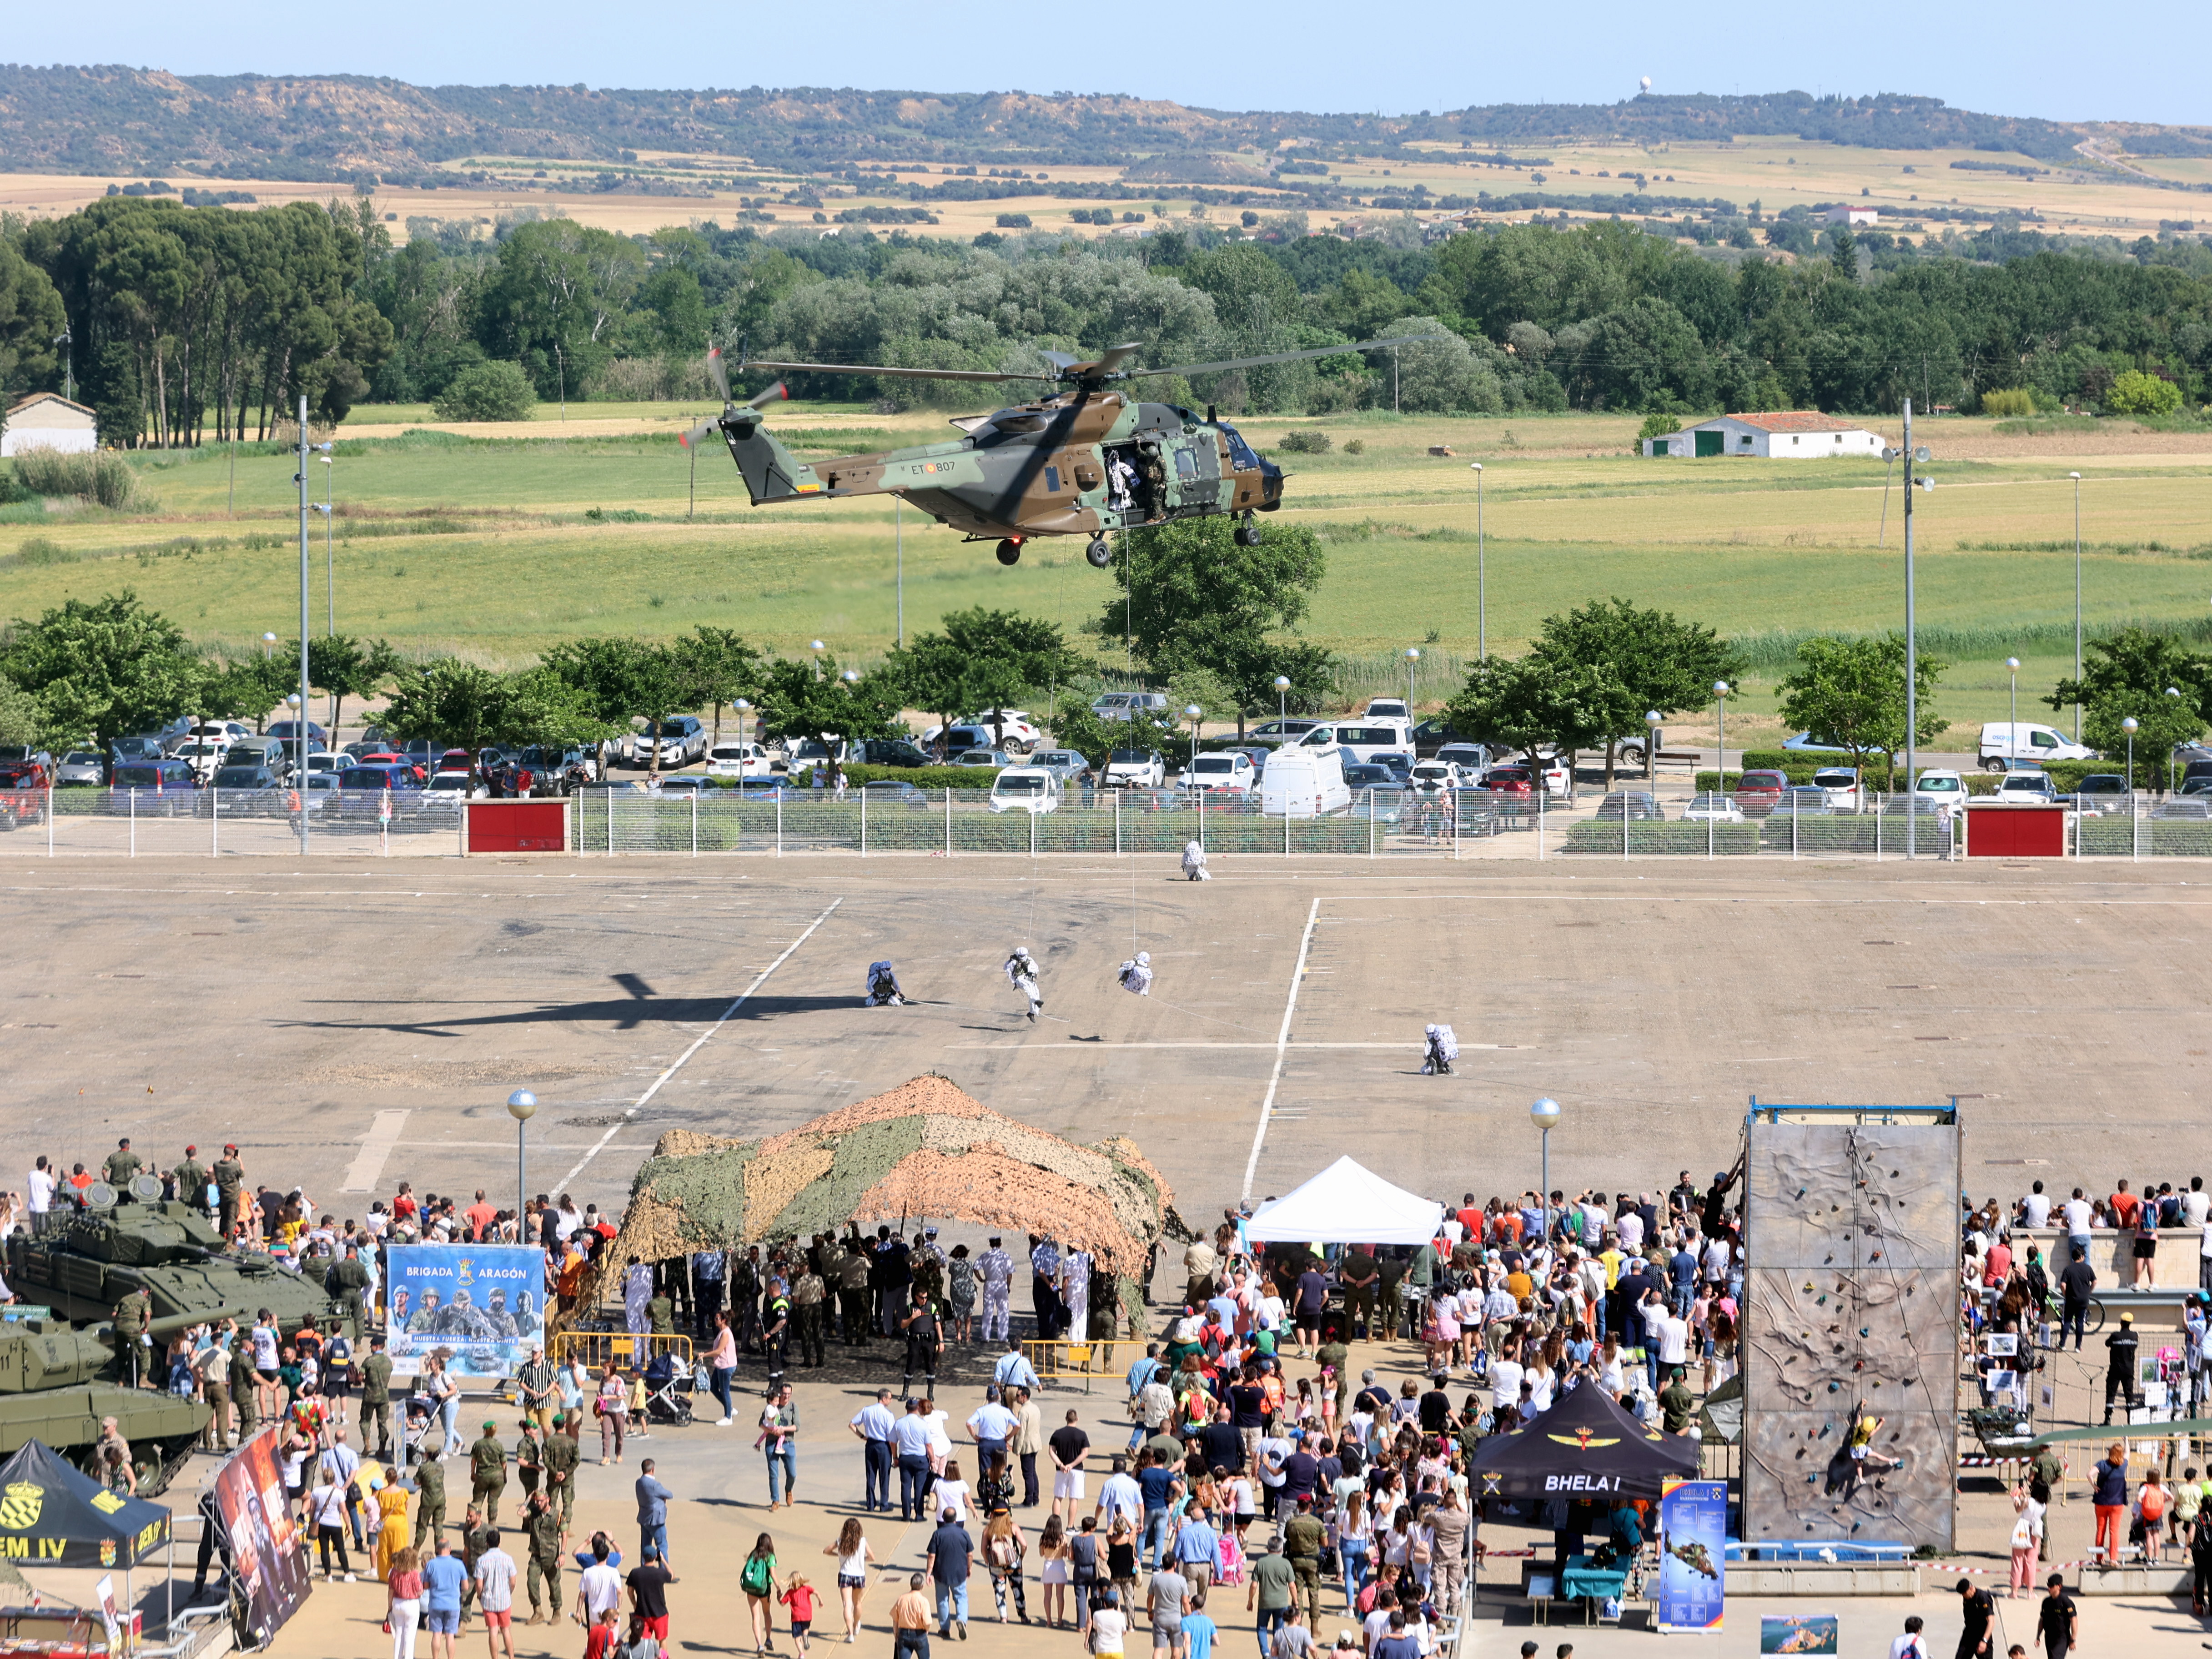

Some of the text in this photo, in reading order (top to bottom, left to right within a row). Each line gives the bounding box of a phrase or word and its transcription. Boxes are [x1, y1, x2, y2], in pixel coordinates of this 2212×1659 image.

[911, 465, 924, 475] ET
[936, 461, 955, 472] 807
[406, 1266, 527, 1279] BRIGADA ARAGÓN
[1545, 1475, 1621, 1492] BHELA I
[39, 1538, 67, 1559] IV
